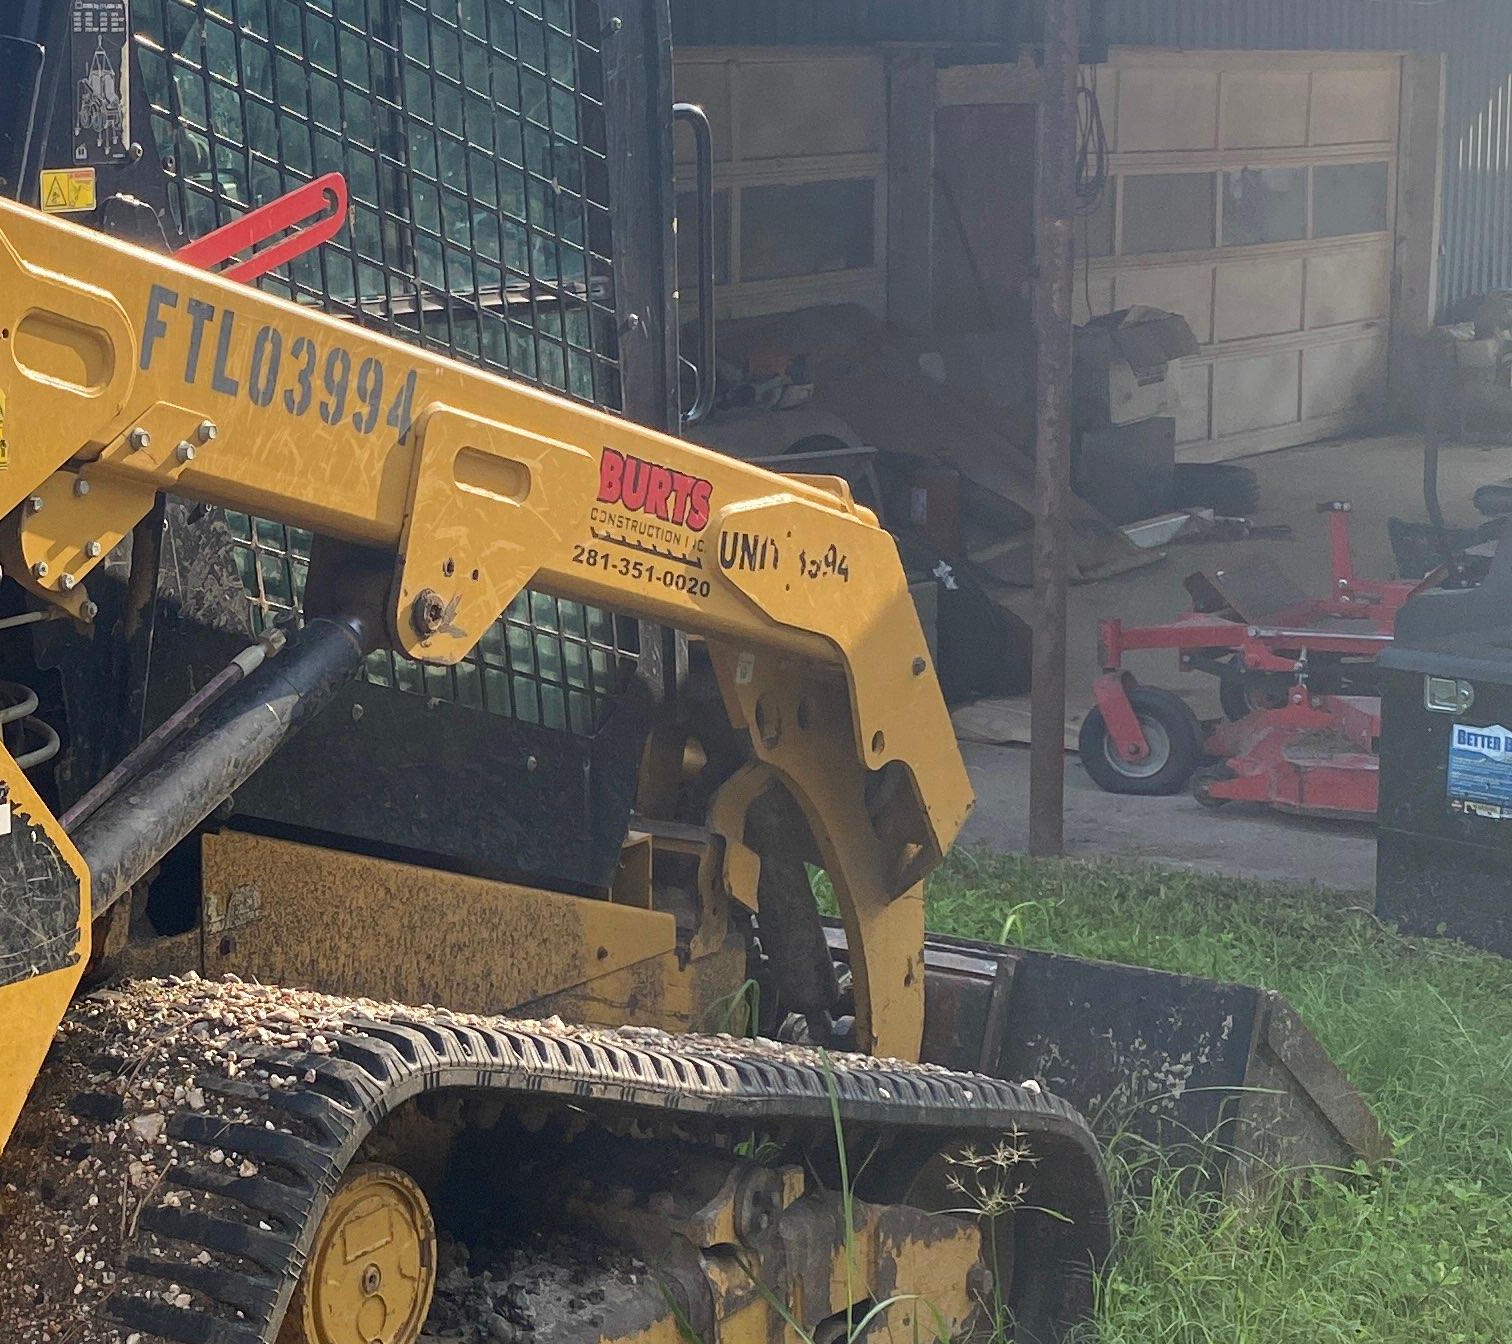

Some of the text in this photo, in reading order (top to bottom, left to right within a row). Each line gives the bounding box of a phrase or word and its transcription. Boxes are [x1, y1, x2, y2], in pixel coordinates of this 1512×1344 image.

[139, 284, 417, 446] FTL03994
[596, 446, 713, 532] BURTS
[589, 507, 681, 546] CONSTRUCTION
[572, 544, 710, 597] 281-351-0020
[1457, 729, 1501, 752] BETTER
